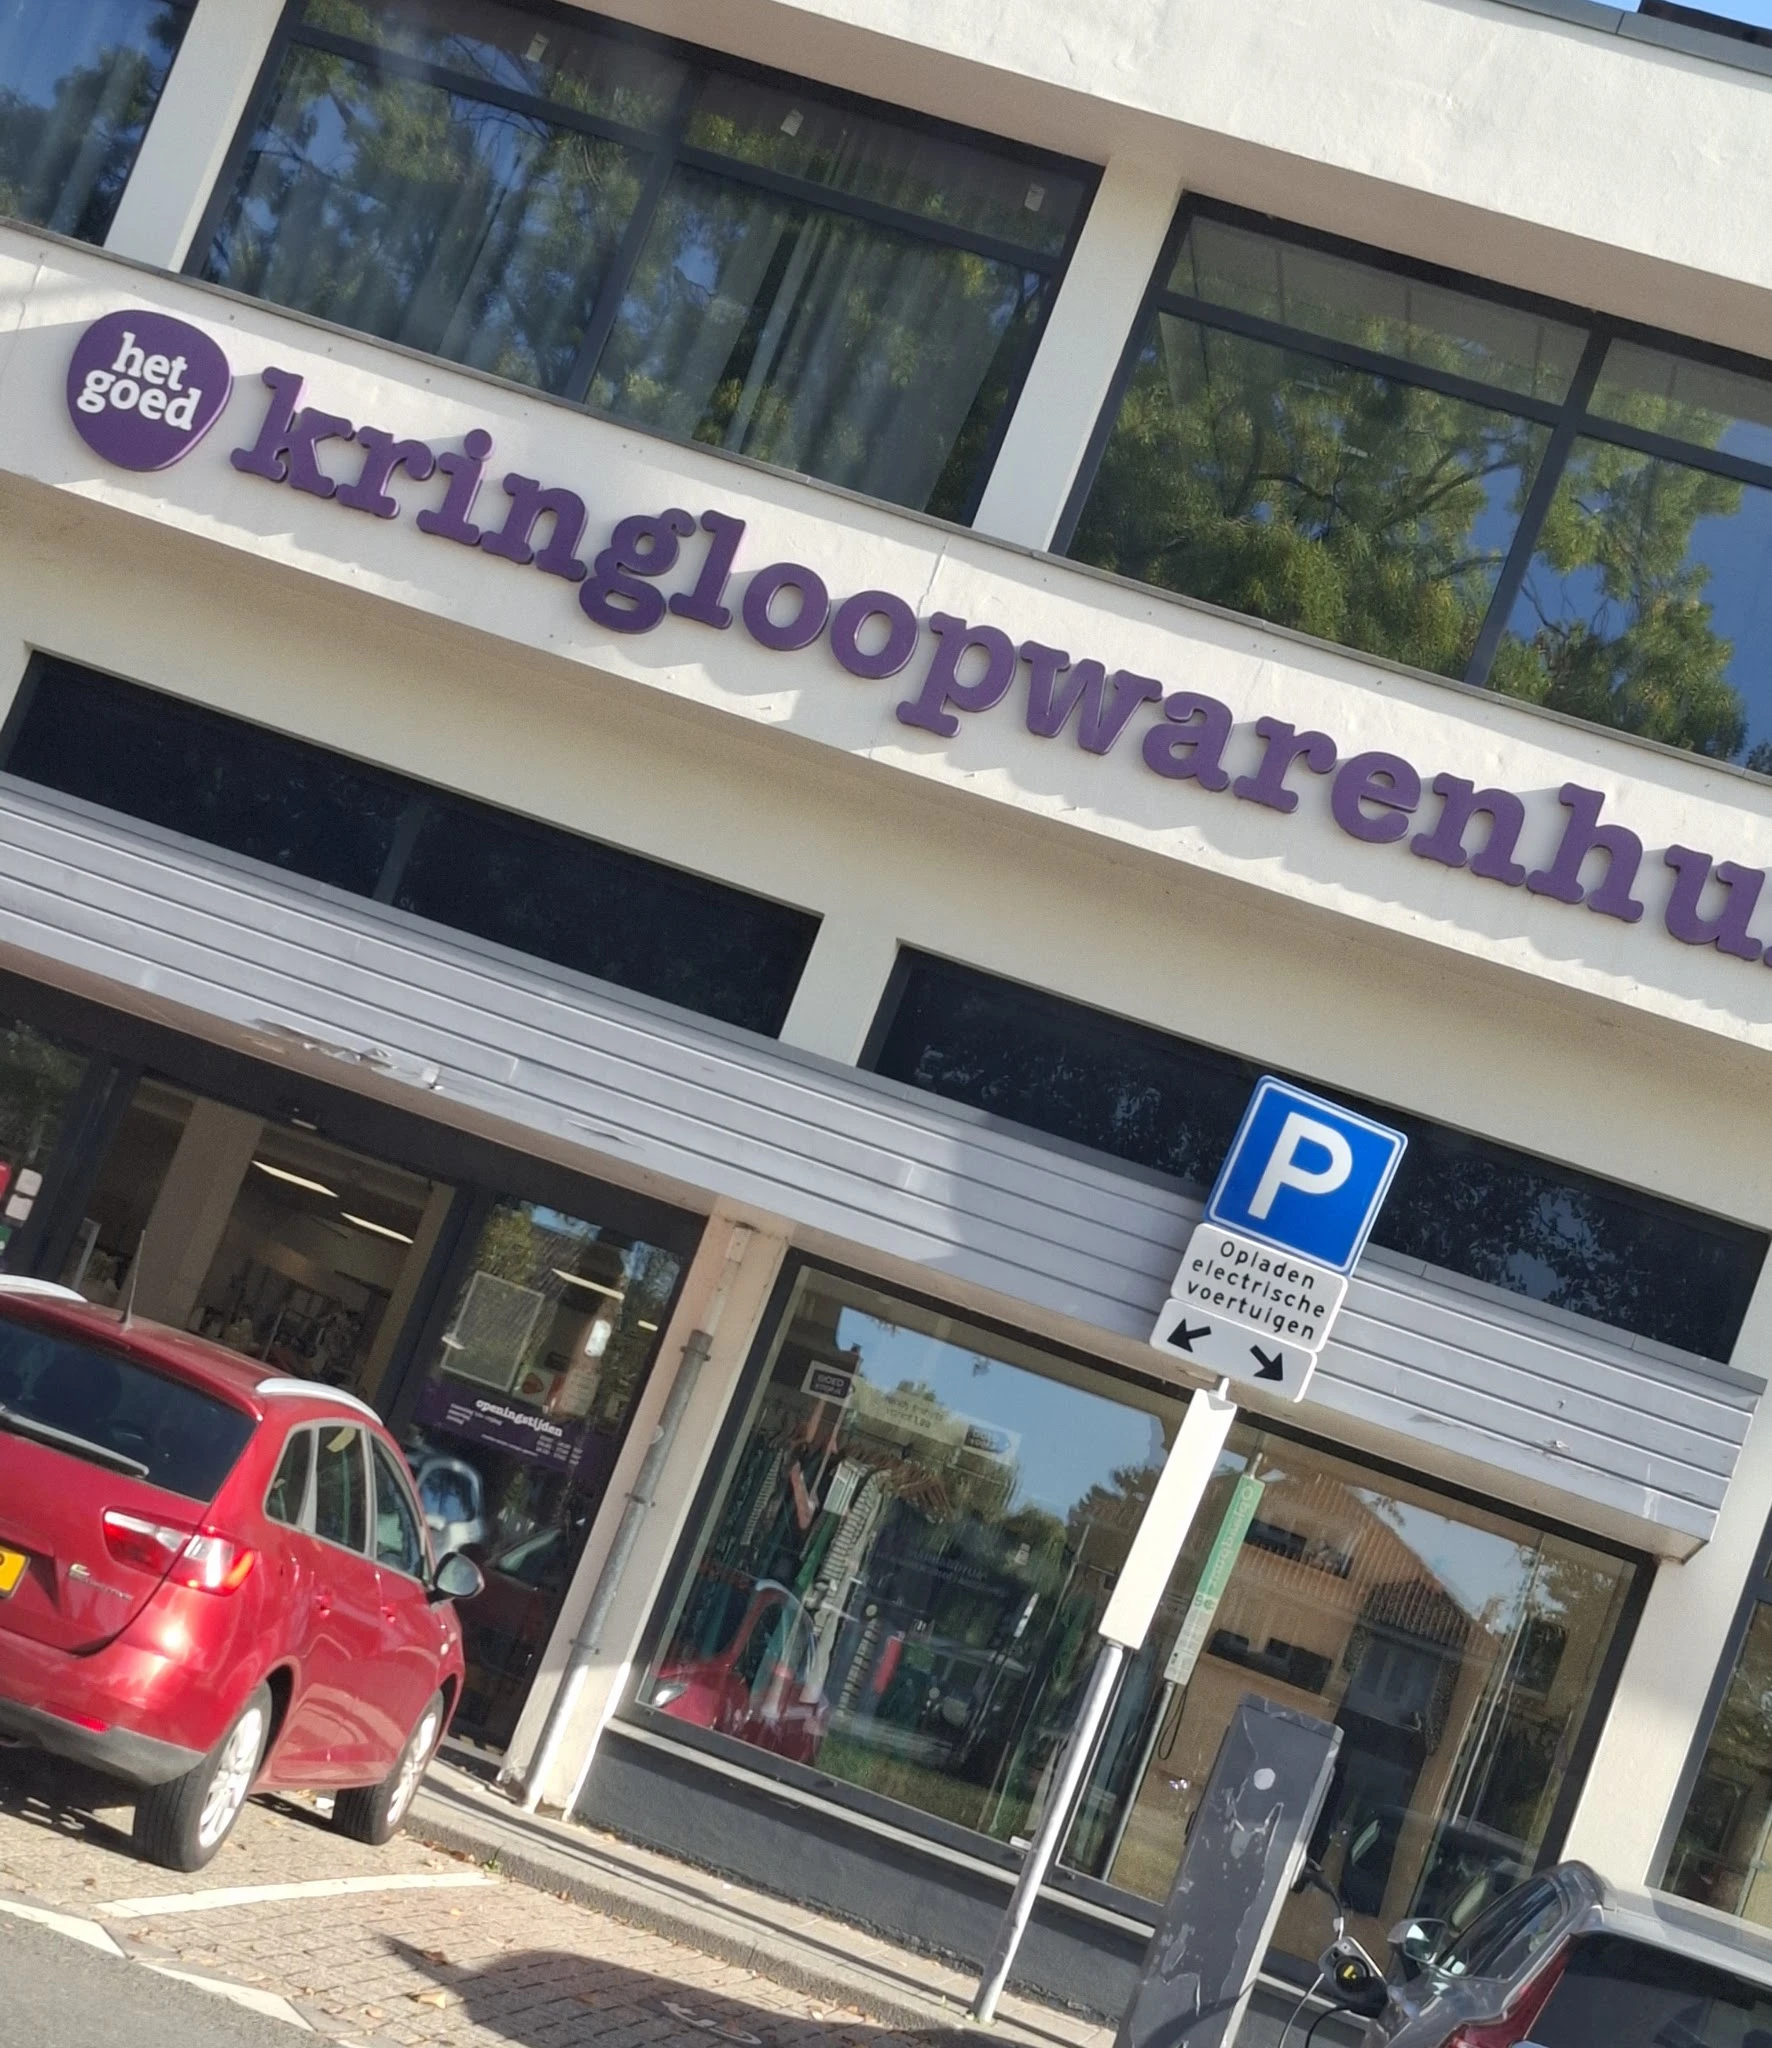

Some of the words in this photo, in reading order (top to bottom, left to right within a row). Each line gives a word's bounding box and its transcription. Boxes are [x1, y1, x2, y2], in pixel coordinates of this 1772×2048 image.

[111, 331, 189, 391] het
[75, 369, 203, 432] goed
[232, 367, 1772, 968] kringloopwarenhu
[1248, 1111, 1353, 1220] P
[1191, 1258, 1326, 1319] electrische
[1220, 1240, 1314, 1290] Opladen
[1186, 1281, 1315, 1340] voertuigen
[475, 1399, 563, 1437] openingstijden
